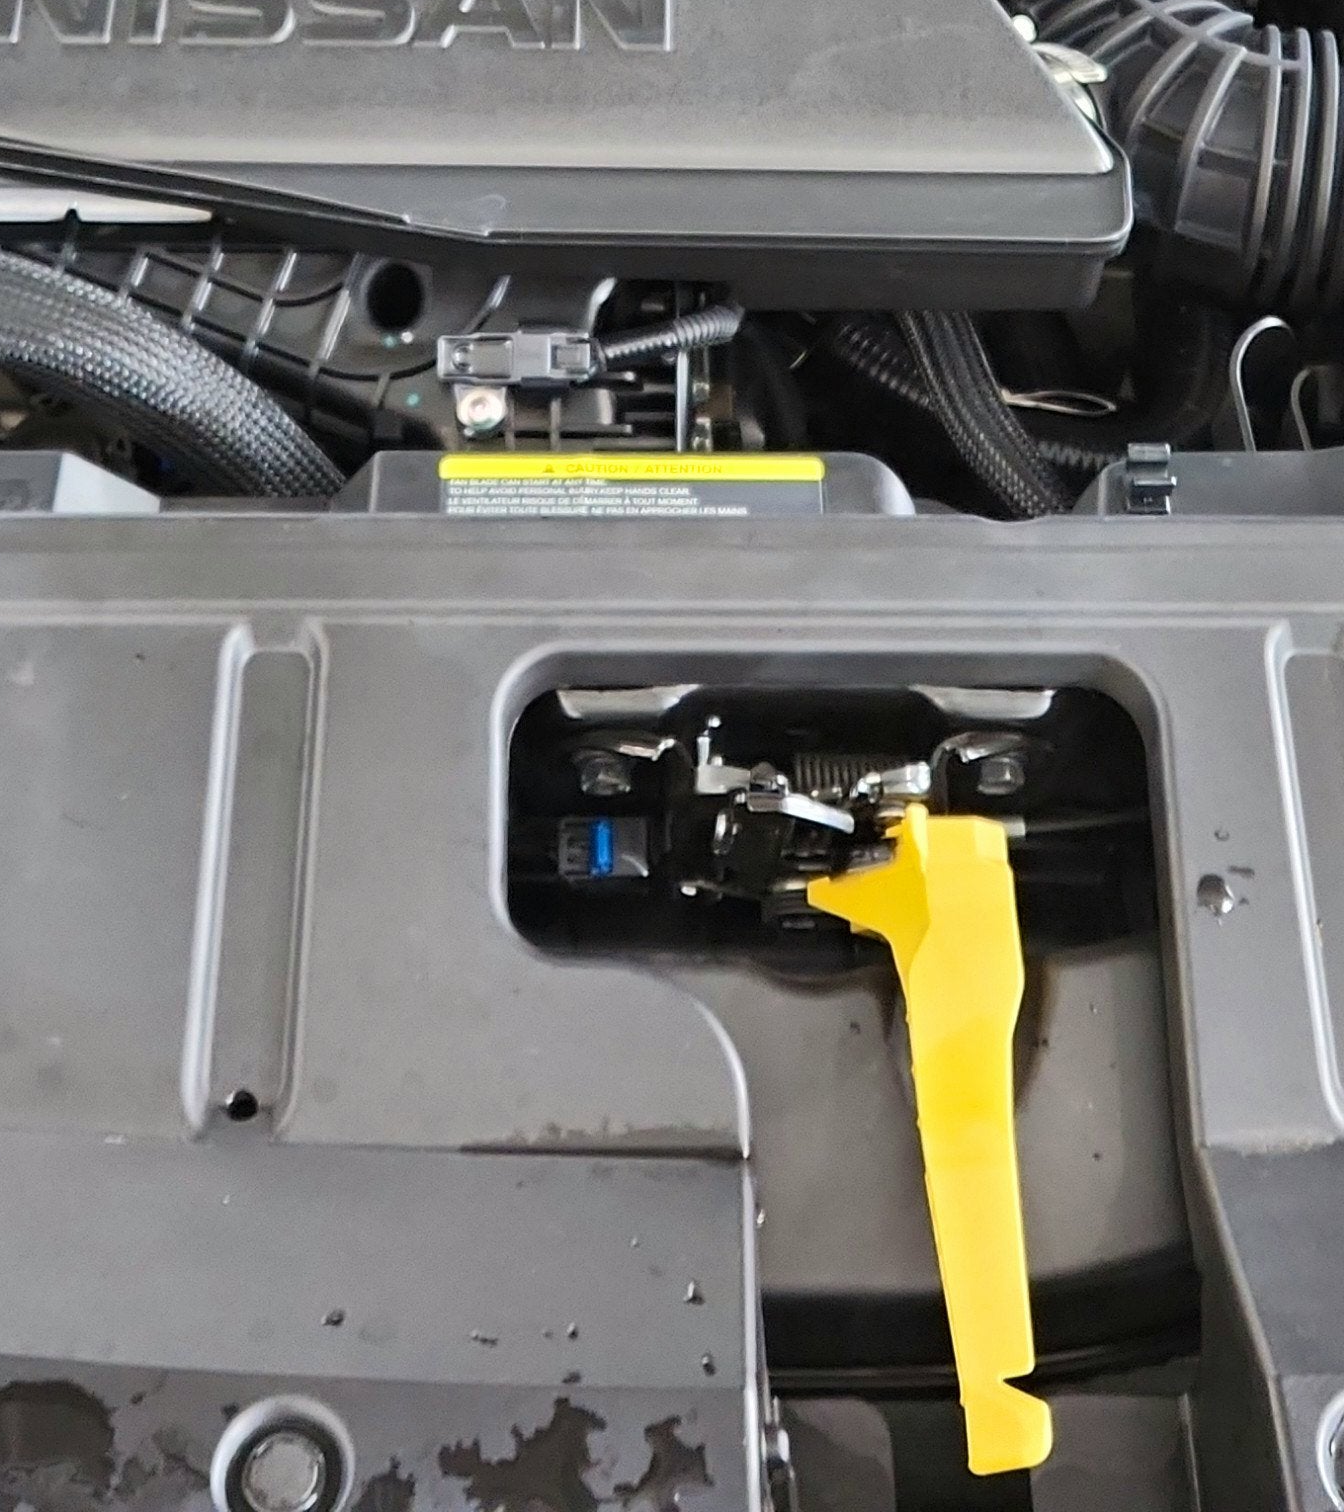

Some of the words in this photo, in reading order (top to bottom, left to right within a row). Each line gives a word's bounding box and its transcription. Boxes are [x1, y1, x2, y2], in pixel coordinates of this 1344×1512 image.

[565, 463, 628, 474] CAUTION
[645, 464, 722, 474] ATTENTION
[449, 487, 462, 495] TO
[464, 487, 487, 495] HELP
[488, 487, 516, 495] AVOID
[518, 487, 566, 495] PERSONAL
[625, 487, 656, 495] HANDS
[448, 497, 458, 505] LE
[462, 497, 520, 505] VENTILATEUR
[522, 497, 555, 505] RISQUE
[558, 497, 570, 505] DE
[633, 497, 656, 505] TOUT
[448, 506, 475, 515] POUR
[509, 506, 538, 515] TOUTE
[606, 506, 624, 515] PAS
[626, 506, 639, 515] EN
[640, 506, 697, 515] APPROCHER
[699, 506, 716, 515] LES
